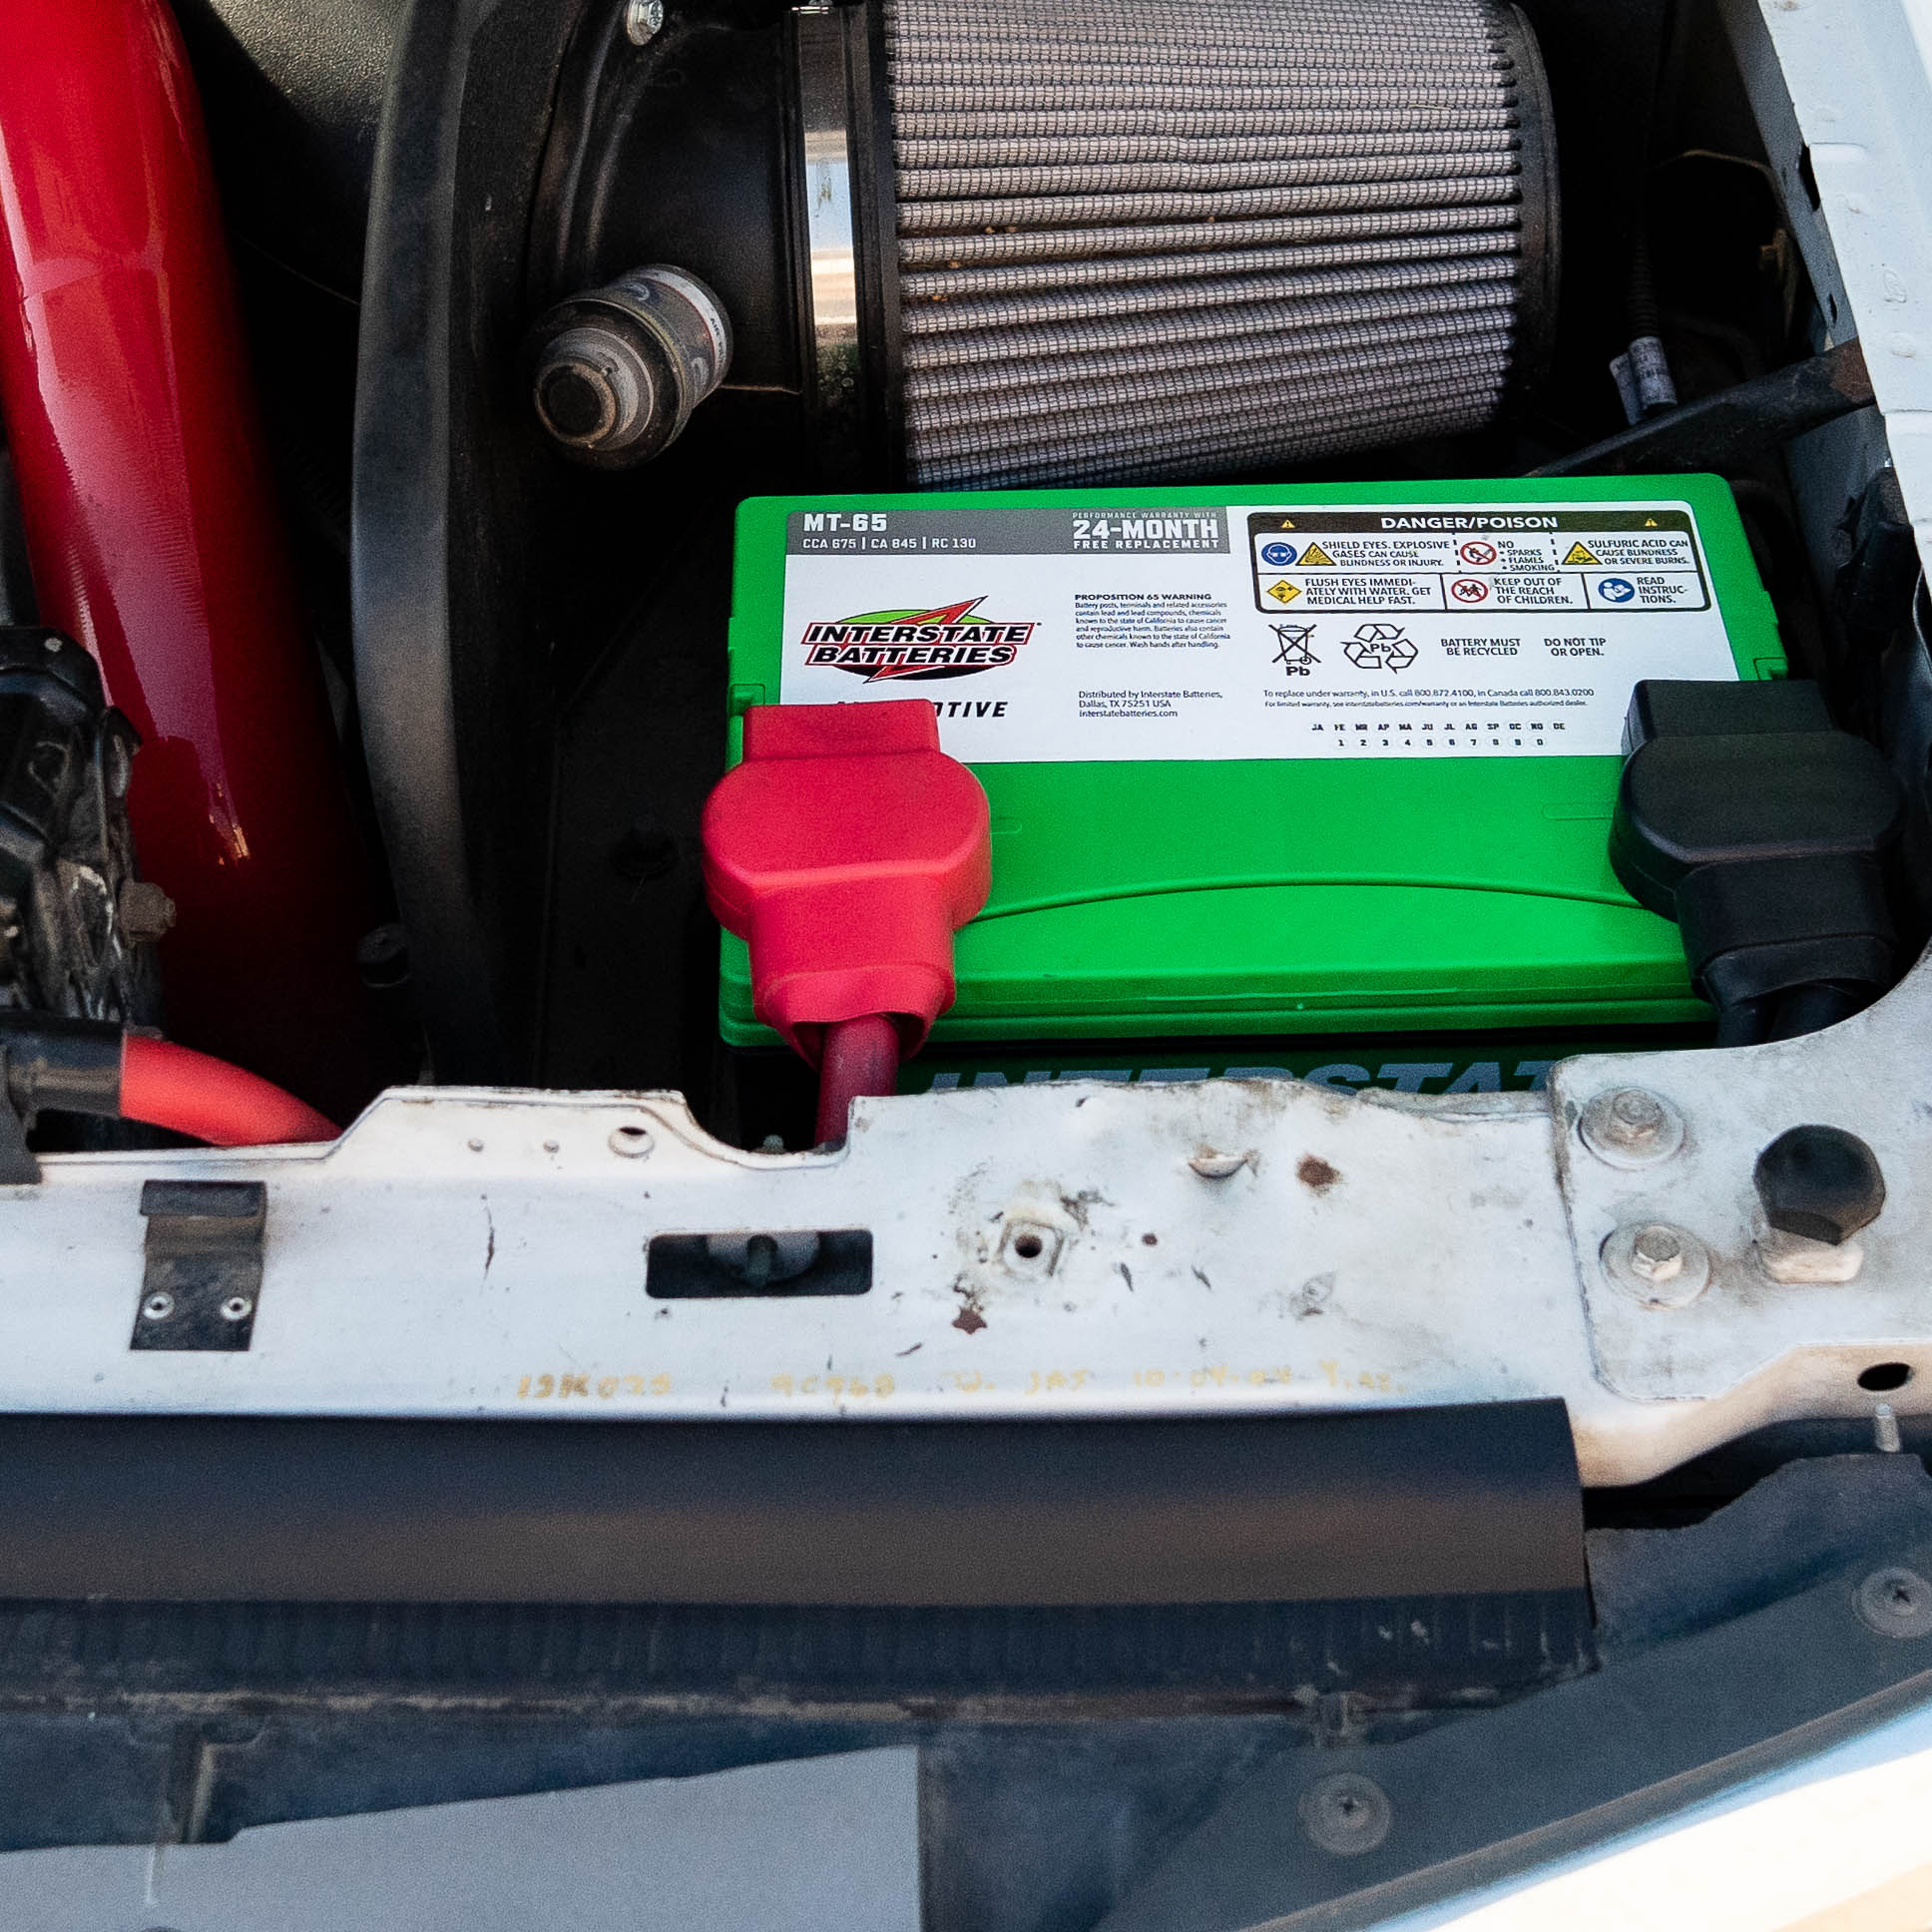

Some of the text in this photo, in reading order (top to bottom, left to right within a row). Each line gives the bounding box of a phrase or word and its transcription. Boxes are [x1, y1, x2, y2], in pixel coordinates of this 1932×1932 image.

[803, 513, 887, 532] MT-65
[1380, 517, 1559, 529] DANGER/POISON
[1072, 519, 1219, 540] 24-MONTH
[802, 538, 977, 549] CCA 675 CA 845 RC 130
[1073, 540, 1219, 550] FREE REPLACEMENT
[1322, 541, 1451, 550] SHIELD EYES. EXPLOSIVE
[1497, 540, 1514, 549] NO
[1588, 539, 1689, 549] SULFURIC ACID CAN
[1604, 557, 1690, 566] OR SEVERE BURNS.
[1305, 578, 1417, 587] FLUSH EYES IMMEDI-
[1493, 577, 1563, 586] KEEP OUT OF
[1637, 576, 1666, 585] READ
[1306, 587, 1432, 596] ATELY WITH WATER. GET
[1495, 586, 1555, 595] THE REACH
[1639, 585, 1690, 595] INSTRUC-
[1074, 593, 1212, 602] PROPOSITION 65 WARNING
[1307, 596, 1416, 605] MEDICAL HELP FAST.
[1497, 595, 1574, 605] OF CHILDREN.
[1641, 595, 1677, 604] TIONS.
[807, 626, 1028, 643] INTERSTATE
[1440, 638, 1521, 648] BATTERY MUST
[1544, 638, 1607, 647] DO NOT TIP
[1369, 643, 1393, 653] Pb
[1446, 647, 1518, 657] BE RECYCLED
[1550, 647, 1606, 657] OR OPEN.
[812, 646, 1013, 664] BATTERIES
[1285, 666, 1310, 677] Pb
[1079, 690, 1223, 701] Distributed by Interstate Batteries,
[1274, 690, 1305, 700] replace
[1477, 689, 1487, 698] in
[1079, 700, 1108, 709] Dallas,
[1079, 709, 1179, 718] interstatebatteries.com
